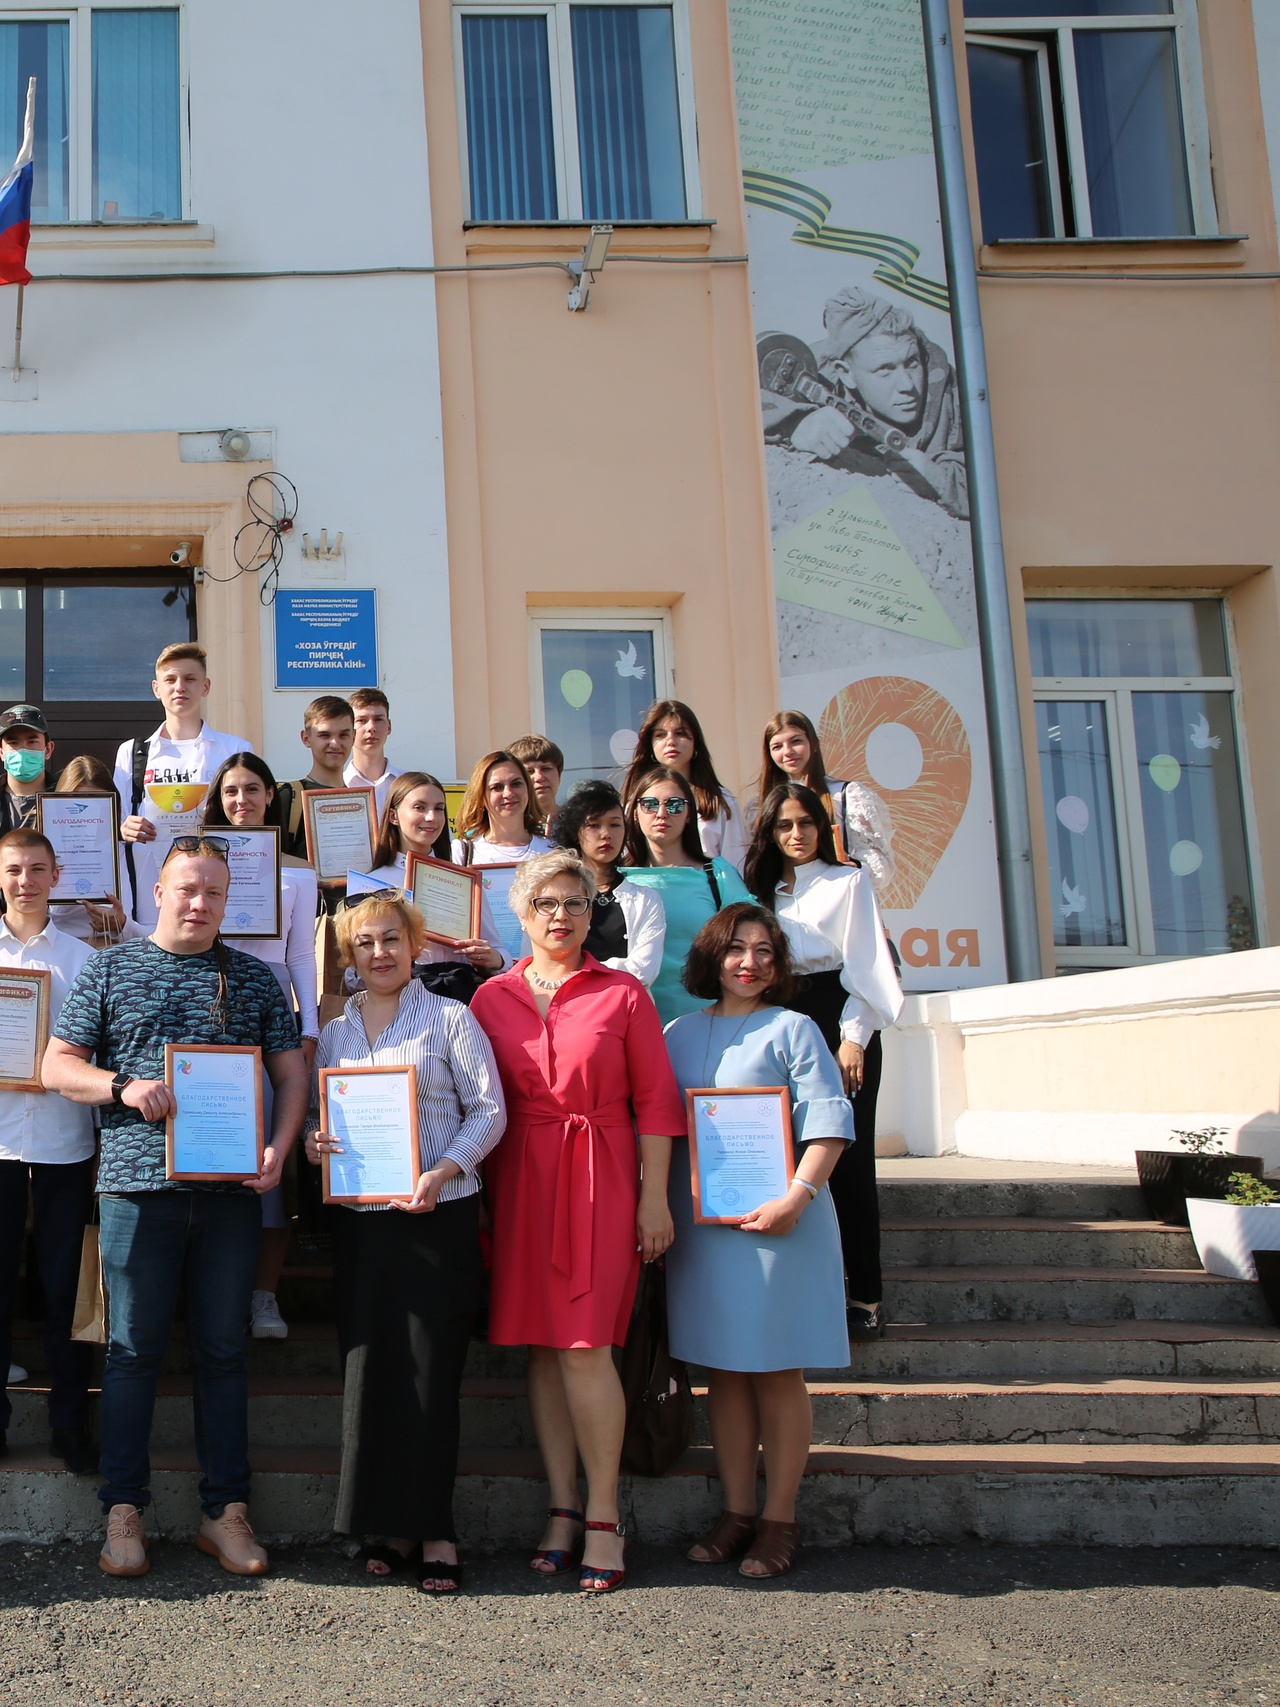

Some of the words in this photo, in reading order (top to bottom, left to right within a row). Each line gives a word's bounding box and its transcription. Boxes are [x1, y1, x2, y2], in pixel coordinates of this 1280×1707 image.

[295, 642, 322, 650] «ХОЗА
[287, 661, 343, 669] РЕСПУБЛИКА
[321, 804, 360, 813] СЕРТИФИКАТ
[424, 872, 463, 888] СЕРТИФИКАТ
[885, 927, 981, 968] ая
[336, 1107, 401, 1115] БЛАГОДАРСТВЕННОЕ
